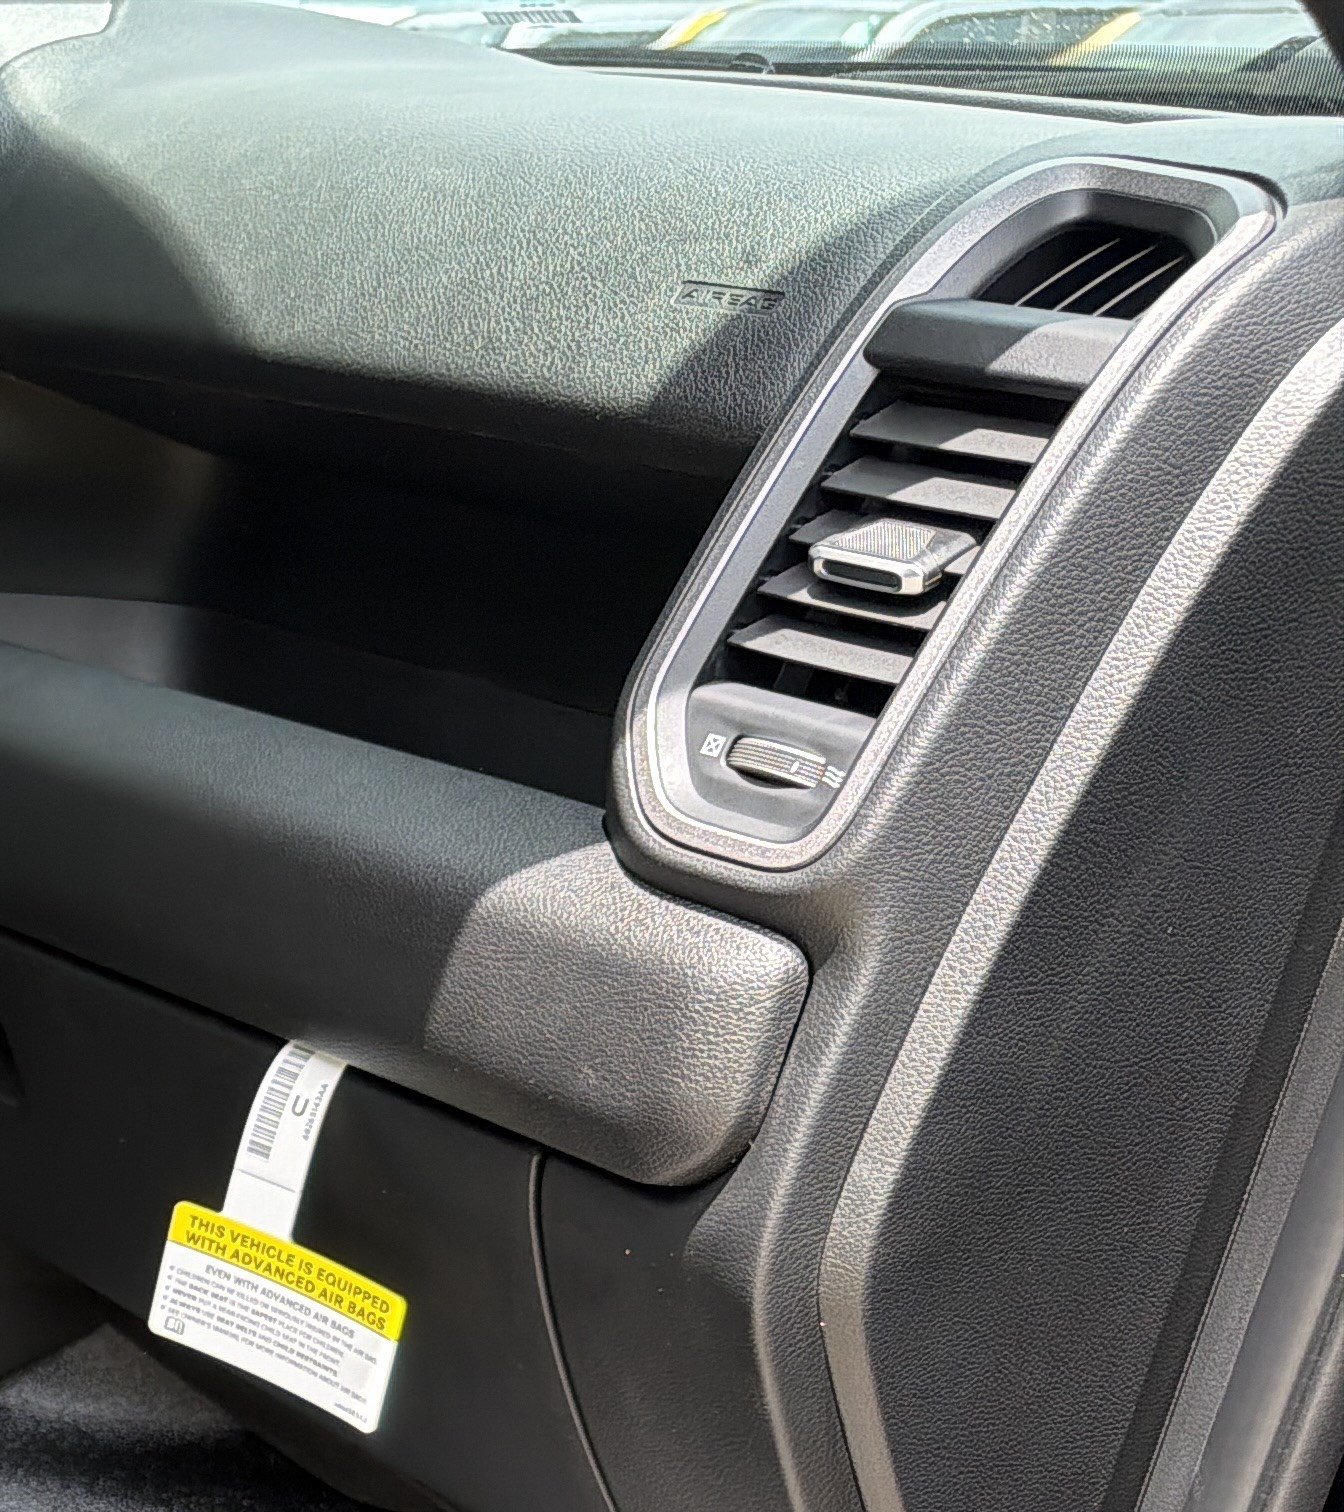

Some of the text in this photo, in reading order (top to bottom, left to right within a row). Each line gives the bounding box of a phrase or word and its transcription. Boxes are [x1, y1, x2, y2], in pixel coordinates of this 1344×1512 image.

[681, 288, 778, 310] AIRBAG
[186, 1230, 387, 1331] WITH ADVANCED AIR BAGS
[189, 1215, 391, 1315] THIS VEHICLE IS EQUIPPED
[205, 1264, 356, 1338] EVEN WITH ADVANCED AIR BAGS
